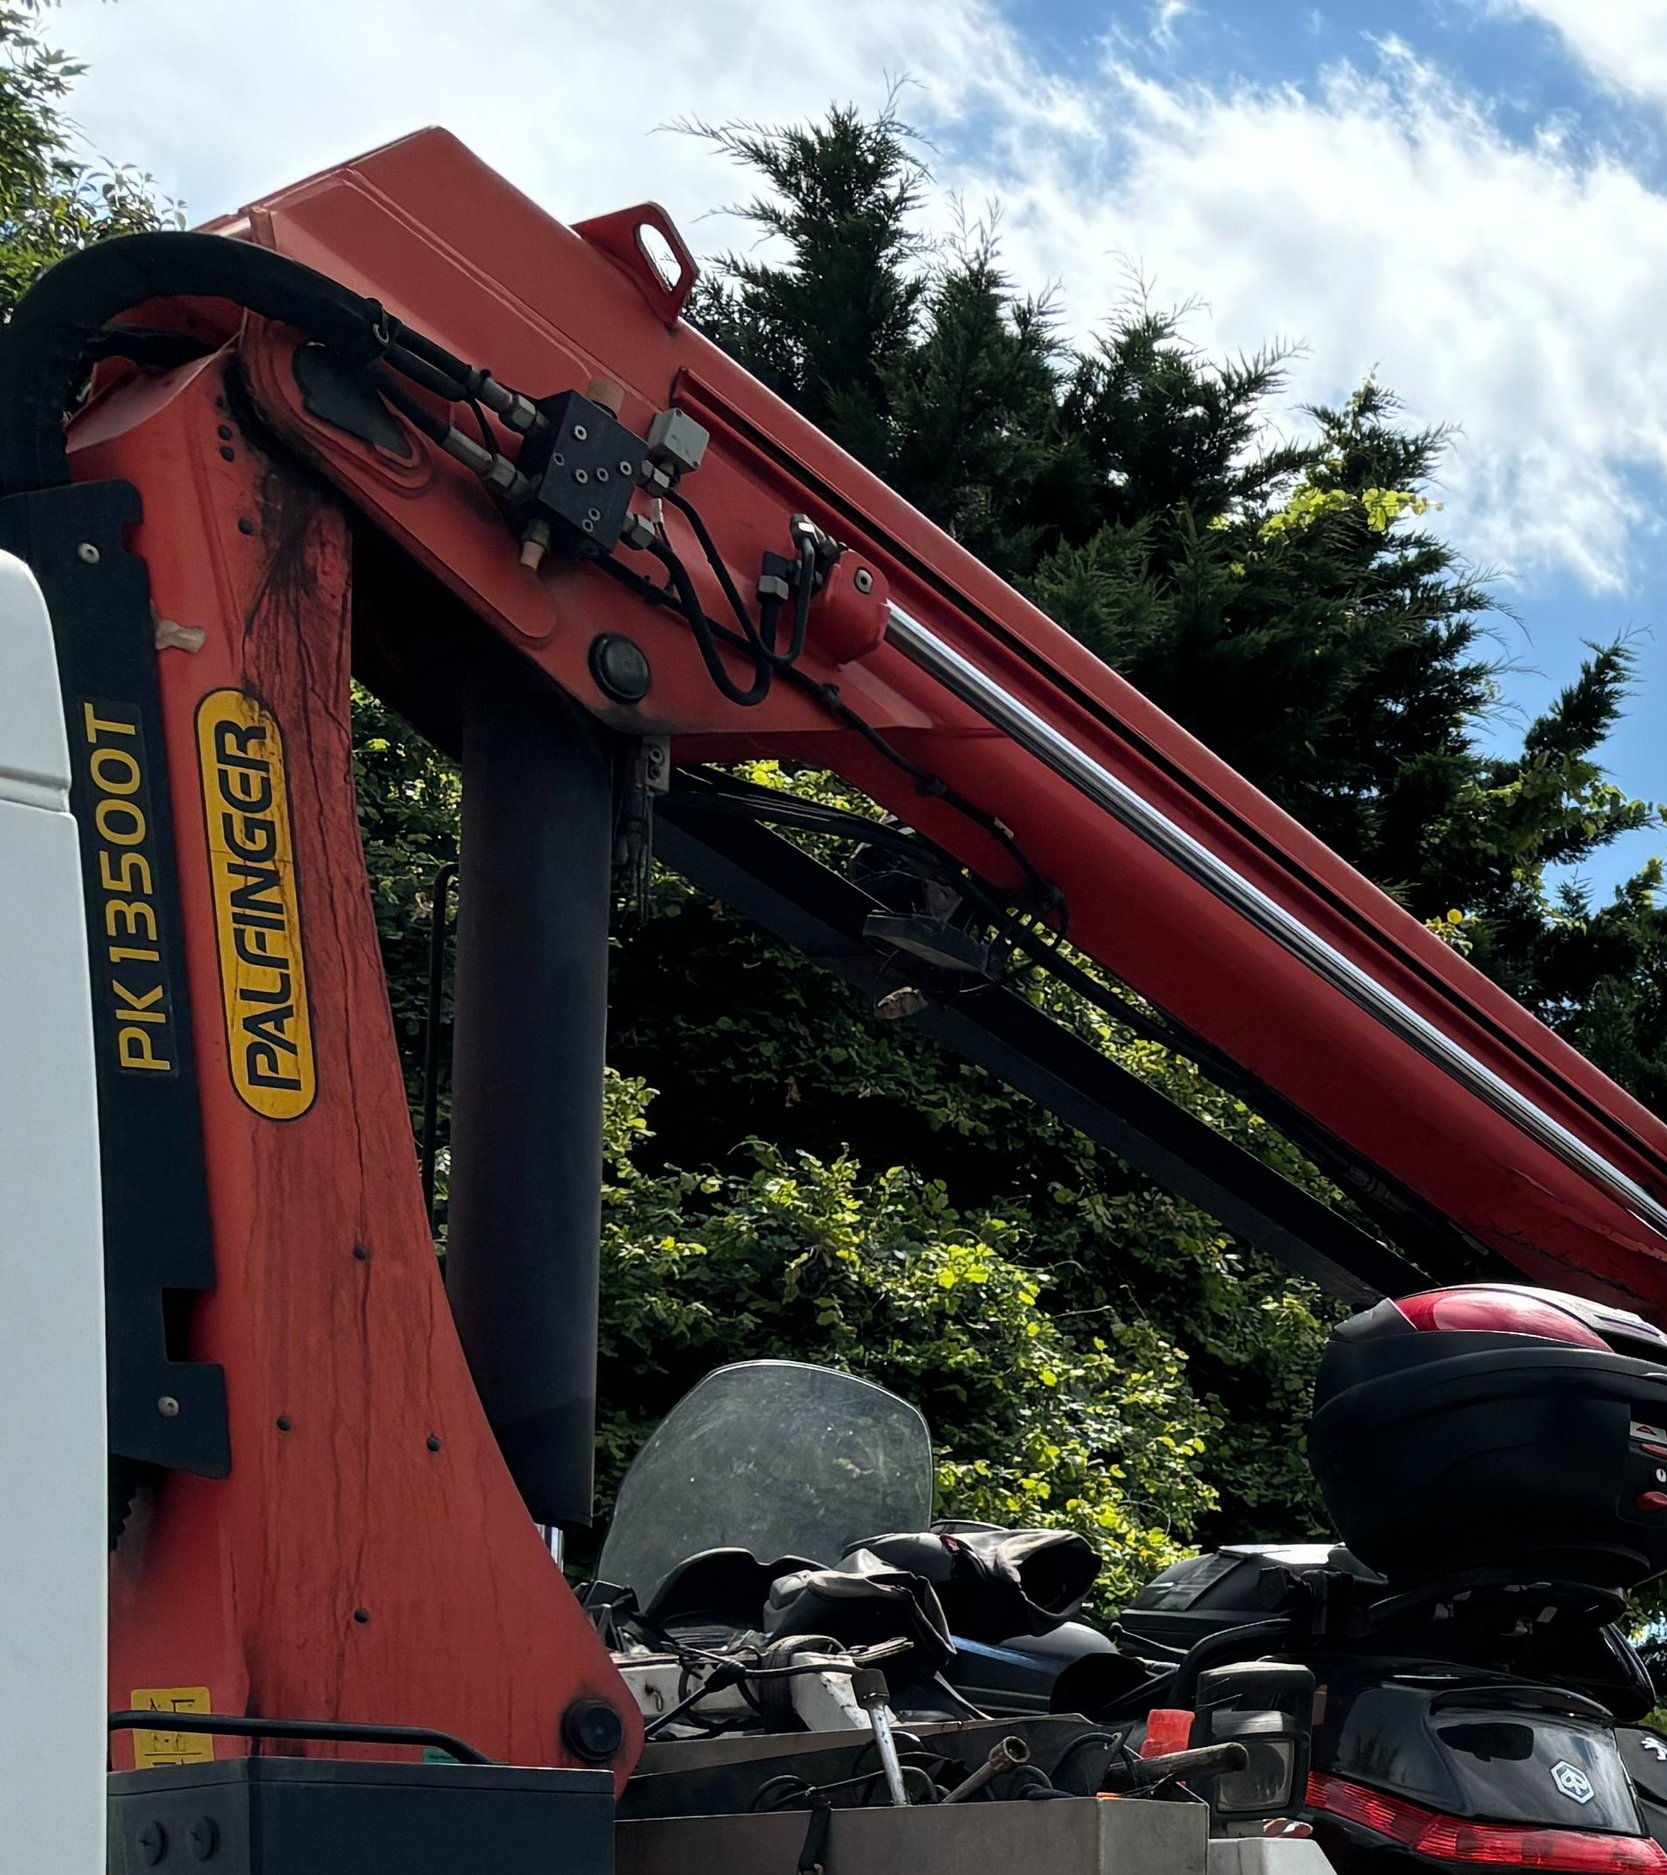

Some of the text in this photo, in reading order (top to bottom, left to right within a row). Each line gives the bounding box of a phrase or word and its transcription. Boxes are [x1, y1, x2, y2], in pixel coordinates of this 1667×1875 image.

[83, 702, 172, 1071] PK 13500T
[214, 717, 302, 1092] PALFINGER
